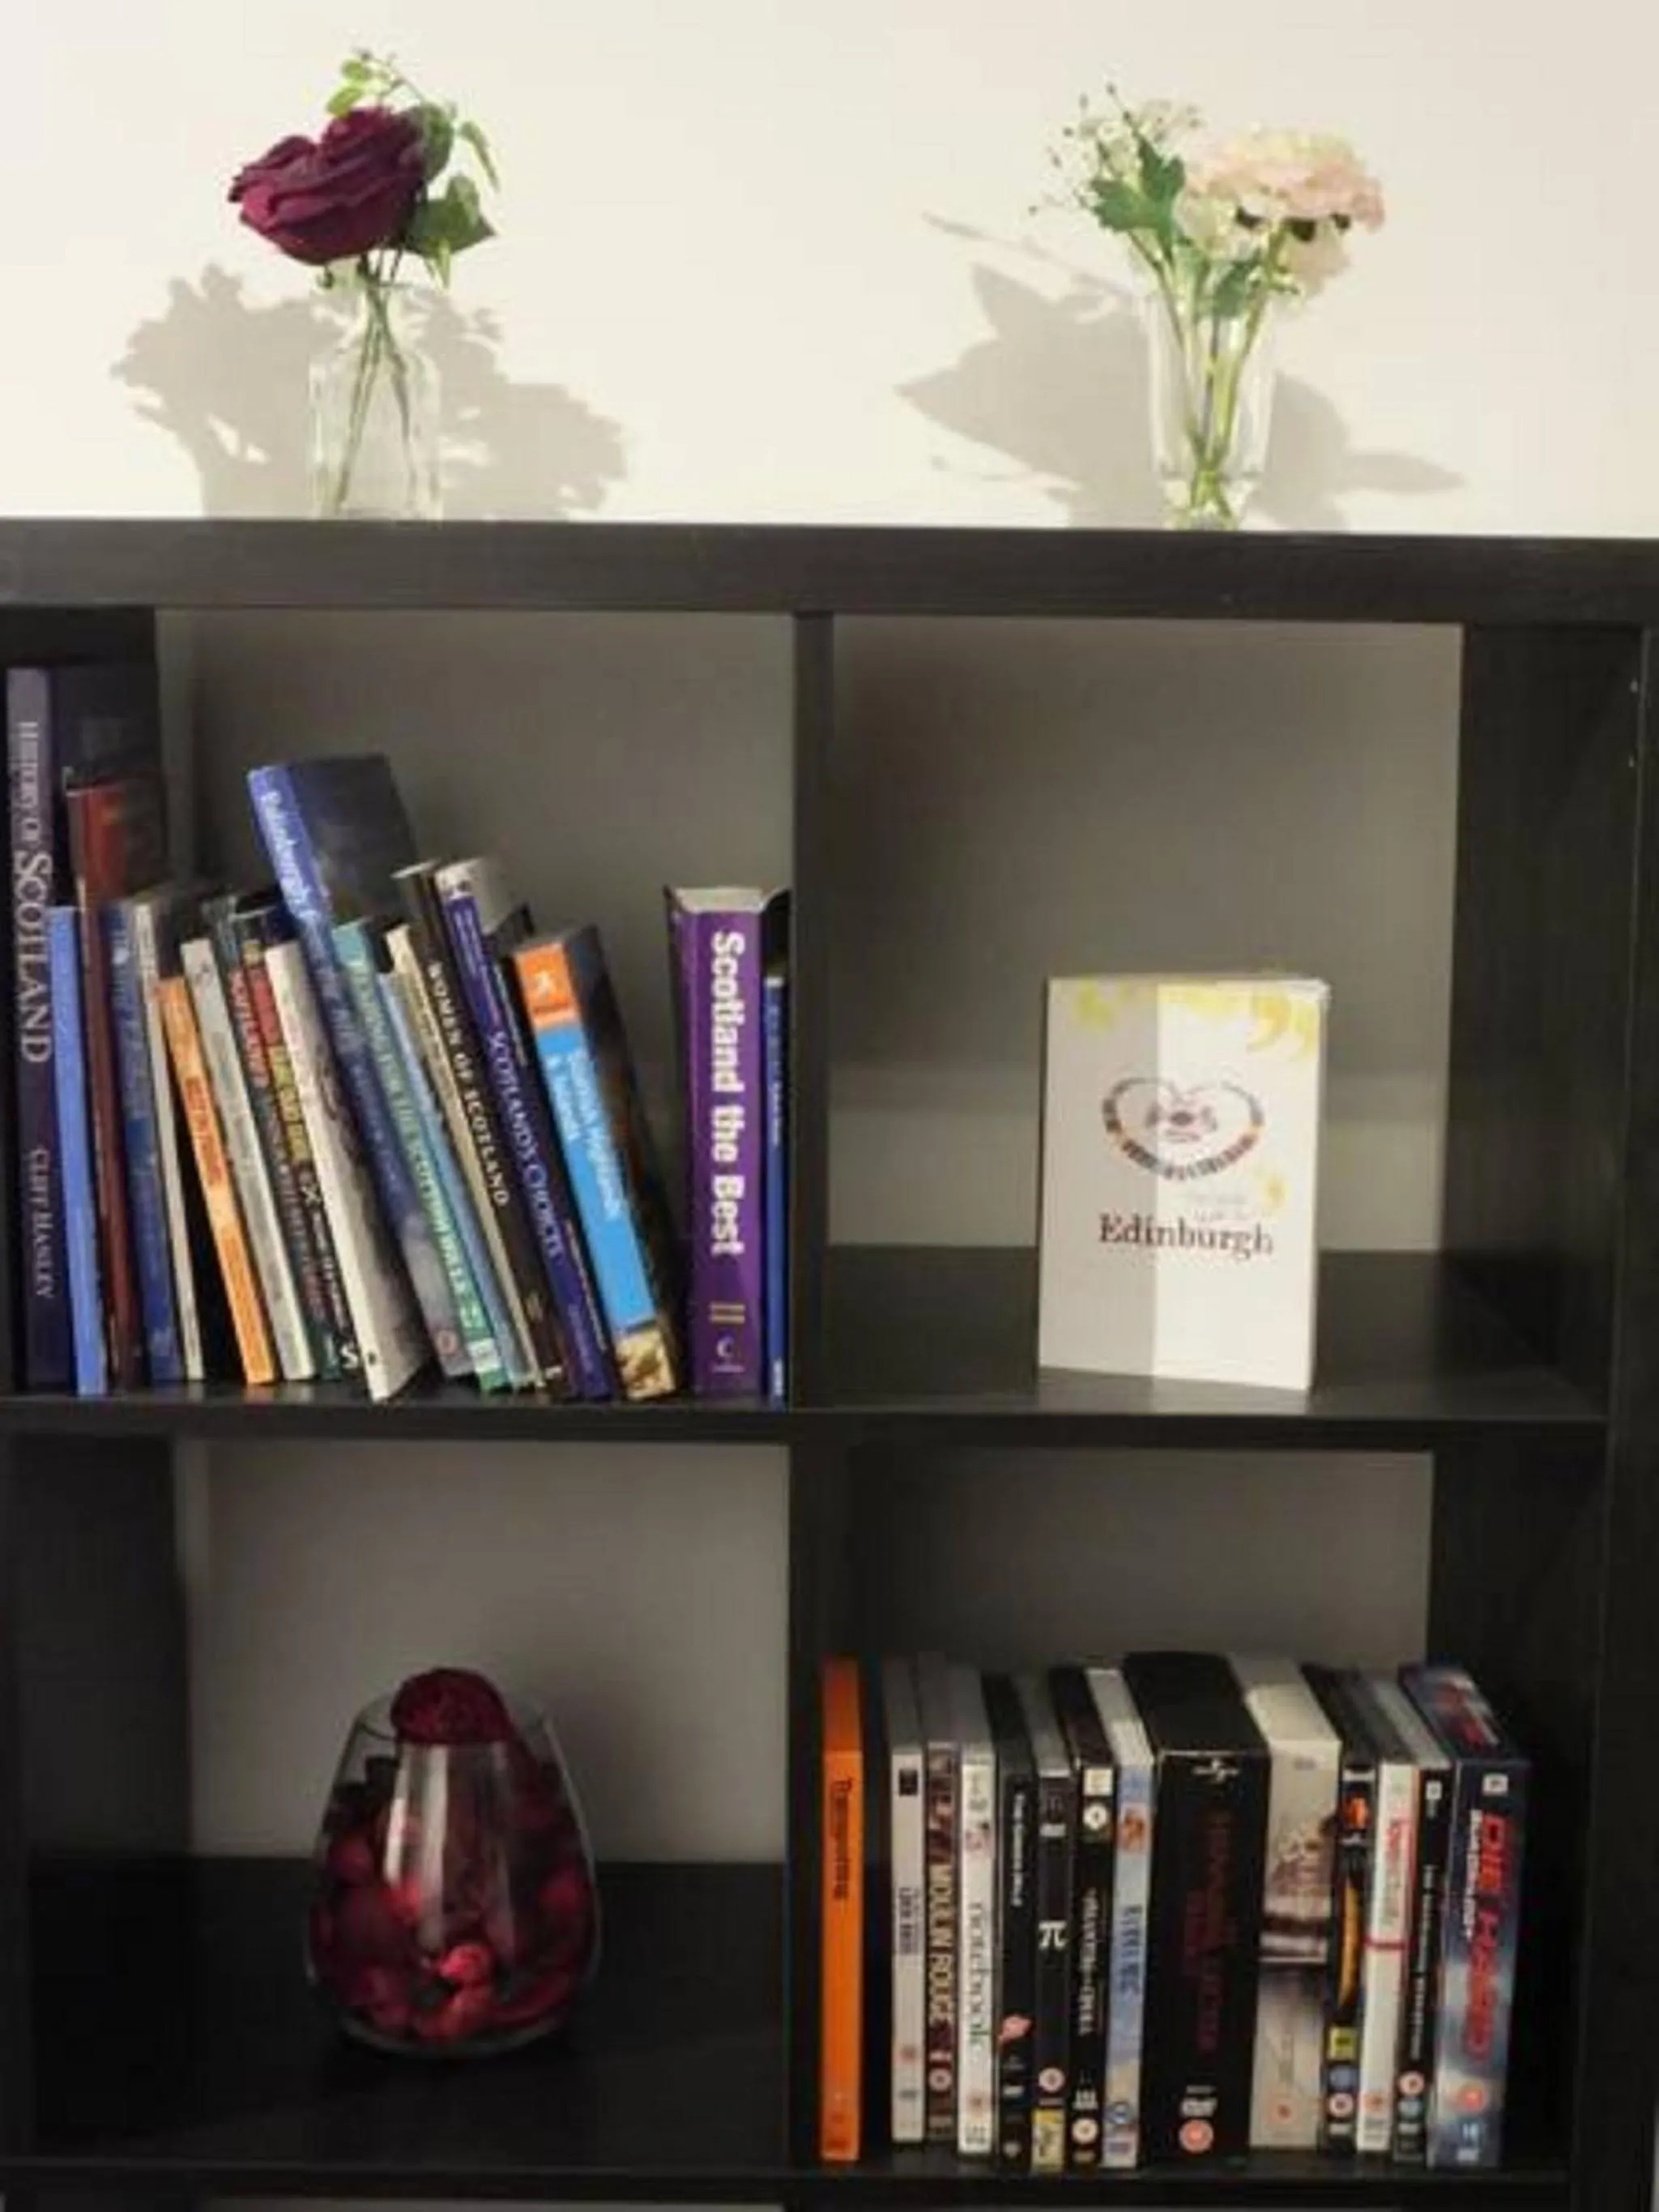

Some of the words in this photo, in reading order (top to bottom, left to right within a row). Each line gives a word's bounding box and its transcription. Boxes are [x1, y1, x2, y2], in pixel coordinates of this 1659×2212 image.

[13, 849, 52, 1064] SCOTLAND
[427, 962, 463, 1045] WOMEN
[711, 930, 746, 1093] Scotland
[455, 1052, 474, 1081] OF
[464, 1089, 510, 1206] SCOTLAND
[711, 1104, 746, 1163] the
[711, 1174, 746, 1257] Best
[1098, 1213, 1273, 1260] Edinburgh
[928, 1952, 955, 2027] ROUGE
